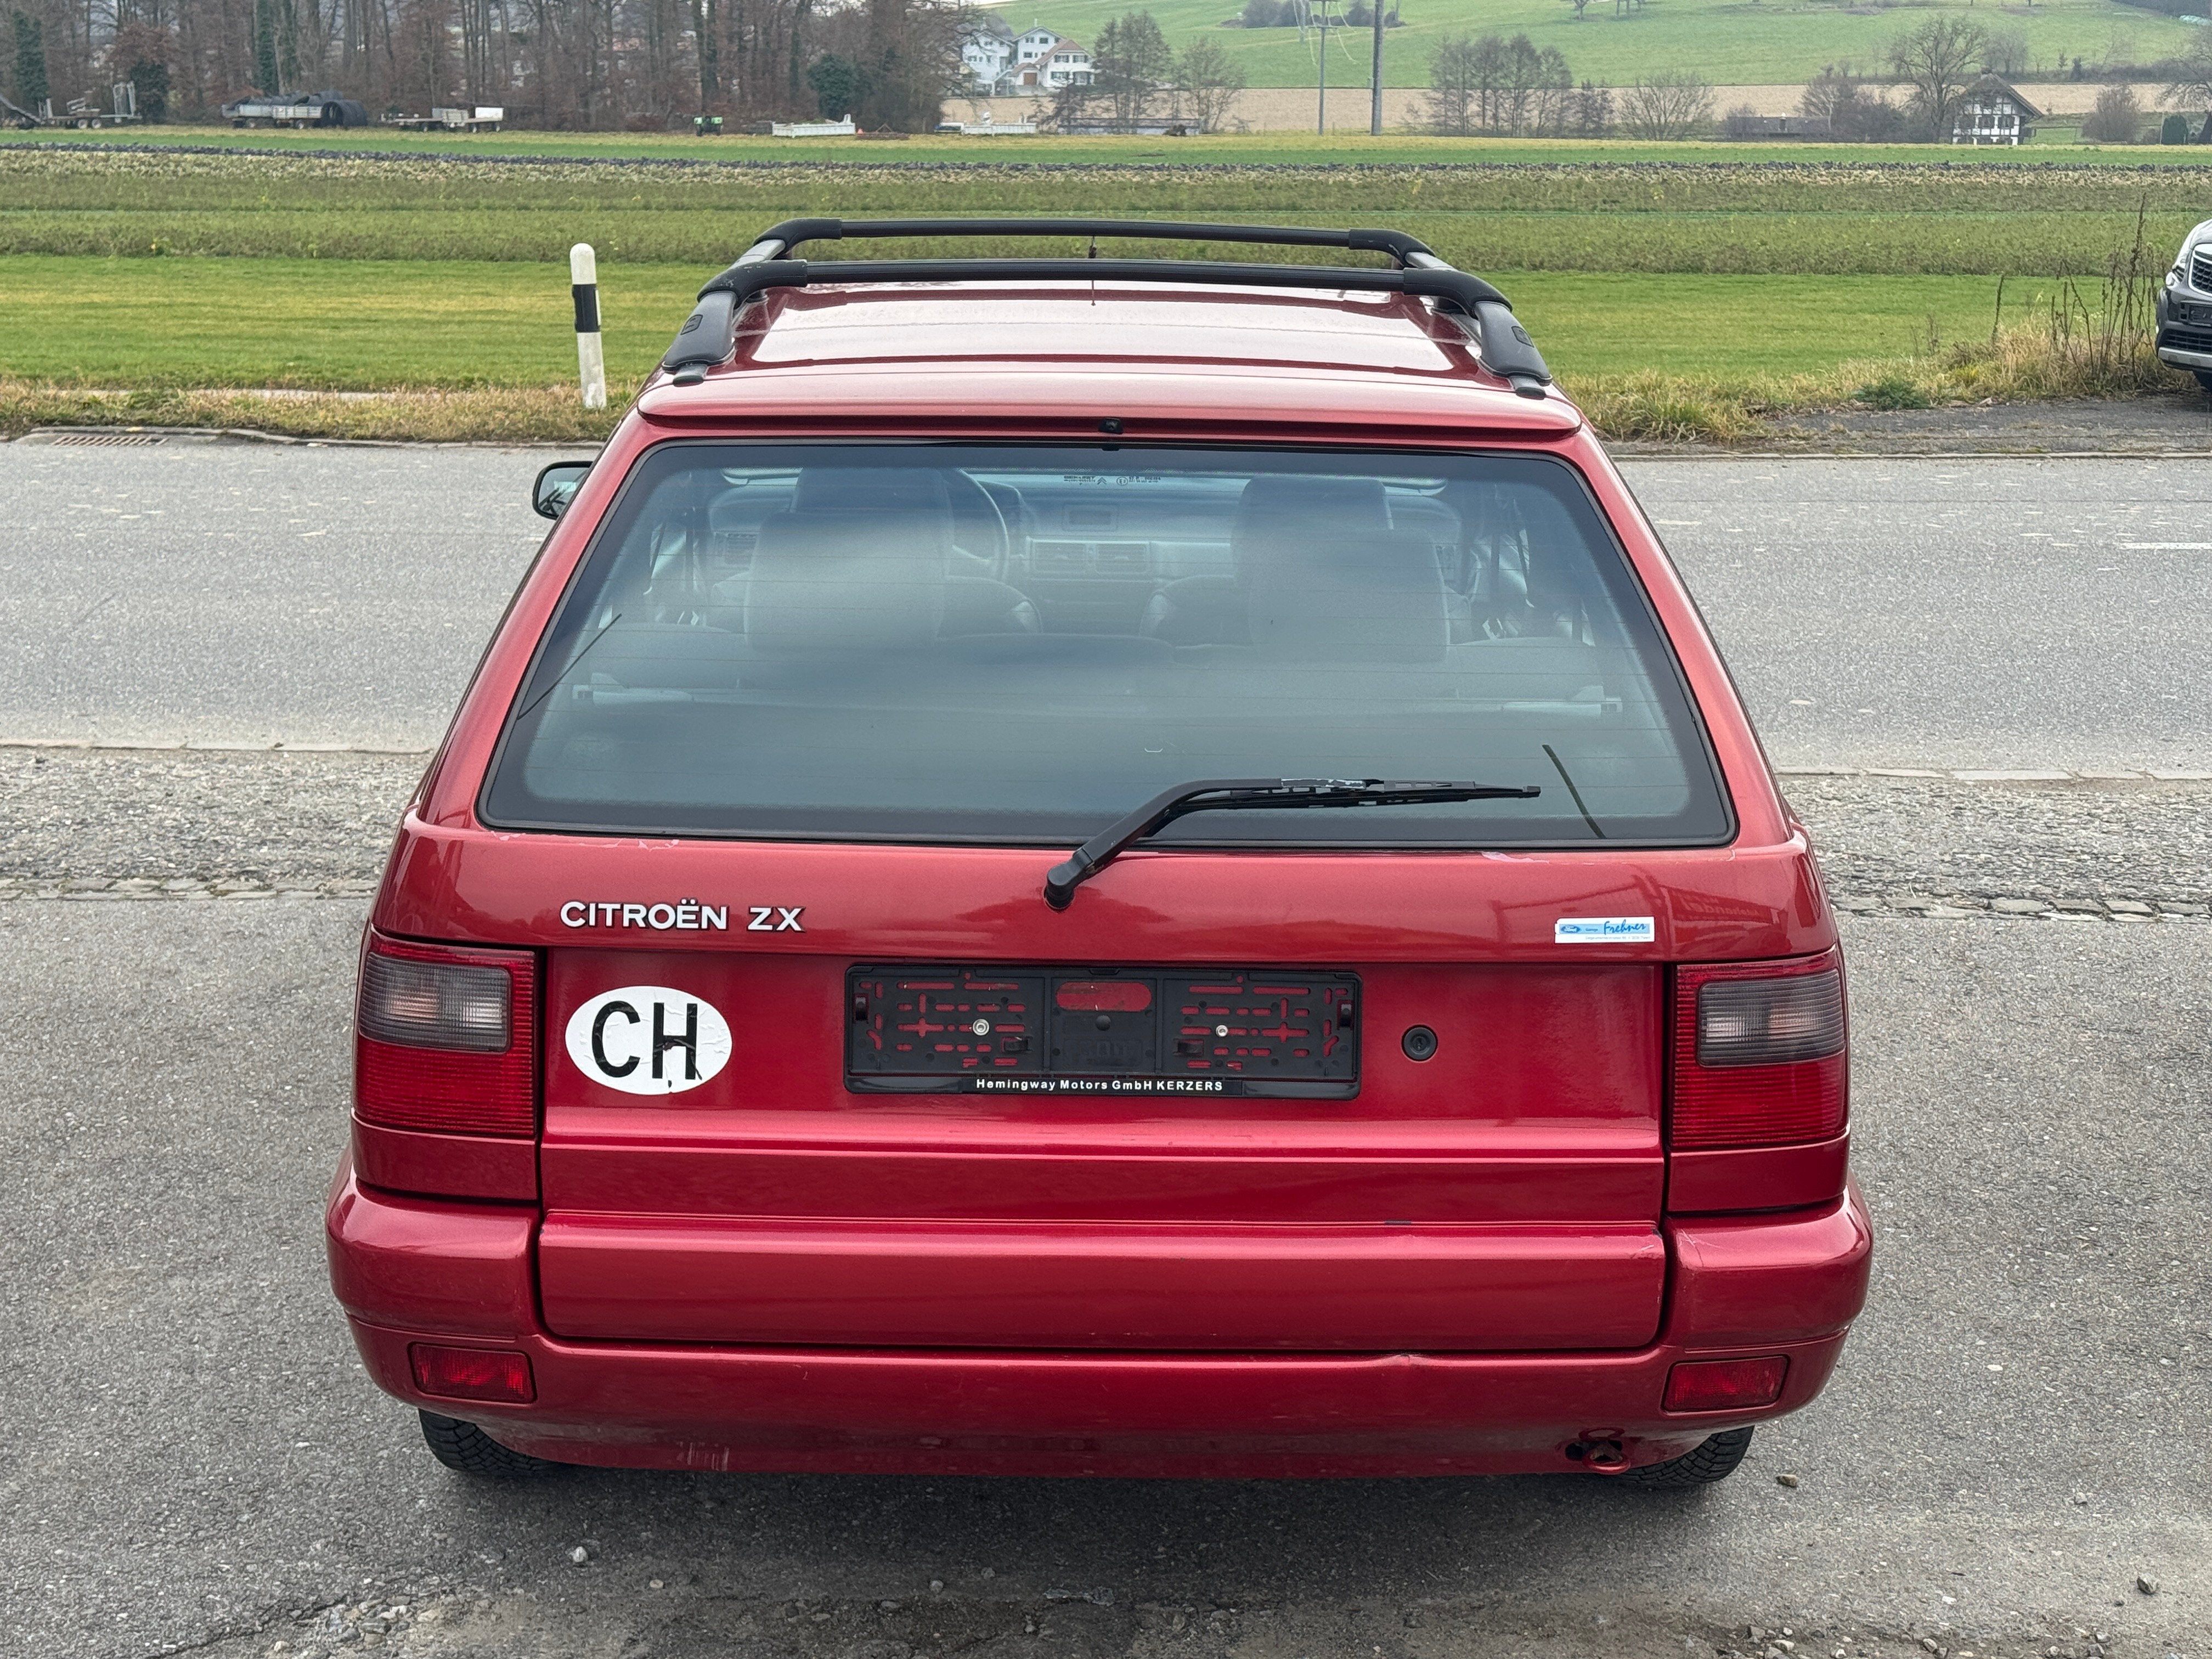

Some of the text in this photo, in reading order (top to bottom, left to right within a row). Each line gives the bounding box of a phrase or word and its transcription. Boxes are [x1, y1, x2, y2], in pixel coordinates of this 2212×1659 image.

[560, 898, 805, 932] CITROËN ZX
[1604, 919, 1646, 935] Frehner
[591, 1000, 699, 1080] CH
[976, 1079, 1223, 1091] Hemingway Motors GmbH KERZERS
